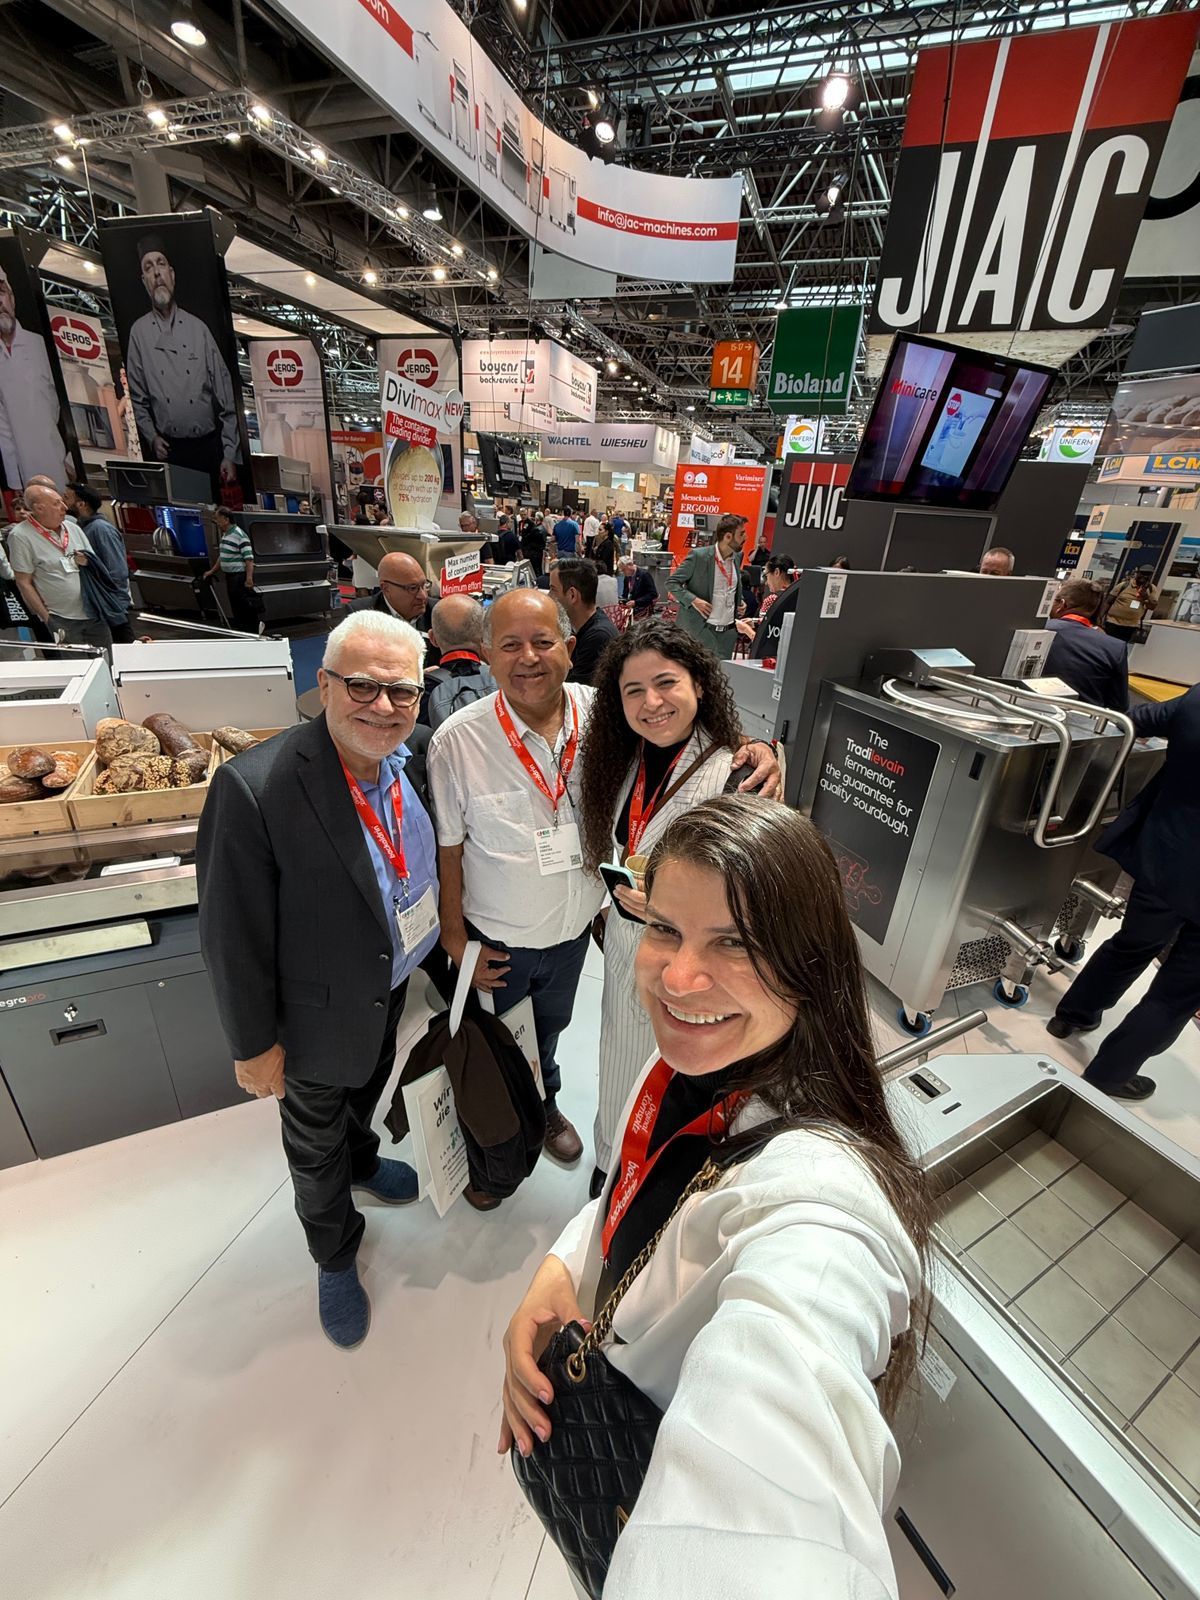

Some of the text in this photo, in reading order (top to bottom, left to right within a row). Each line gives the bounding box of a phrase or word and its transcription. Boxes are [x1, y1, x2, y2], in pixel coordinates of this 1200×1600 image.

[366, 0, 390, 25] om
[597, 207, 718, 237] info@jac-machines.com
[877, 134, 1149, 327] JAC
[61, 331, 92, 346] JEROS
[273, 363, 297, 373] JEROS
[405, 364, 431, 374] JEROS
[479, 359, 519, 375] boyens
[720, 356, 743, 384] 14
[479, 375, 518, 384] backservice
[774, 372, 845, 394] Bioland
[890, 377, 938, 401] Minicare
[386, 378, 443, 421] Divimax
[444, 402, 464, 416] NEW
[389, 423, 432, 445] loading divider
[392, 413, 431, 435] The container
[547, 435, 592, 447] WACHTEL
[600, 438, 648, 448] WIESHEU
[1060, 438, 1094, 446] UNIFERM
[1153, 455, 1200, 469] LCM
[680, 503, 720, 513] ERGO100
[681, 493, 721, 502] Messeknaller
[784, 484, 847, 530] JAC
[447, 553, 479, 568] Max number
[447, 563, 479, 578] of containers
[442, 581, 482, 595] Minimum effort
[868, 729, 889, 750] The
[846, 737, 905, 777] Tradilevain
[844, 754, 897, 793] fermentor,
[825, 762, 913, 818] the guarantee for
[820, 778, 910, 837] quality sourdough.
[433, 1086, 452, 1112] Wir
[436, 1105, 451, 1128] die
[641, 1103, 657, 1134] Original
